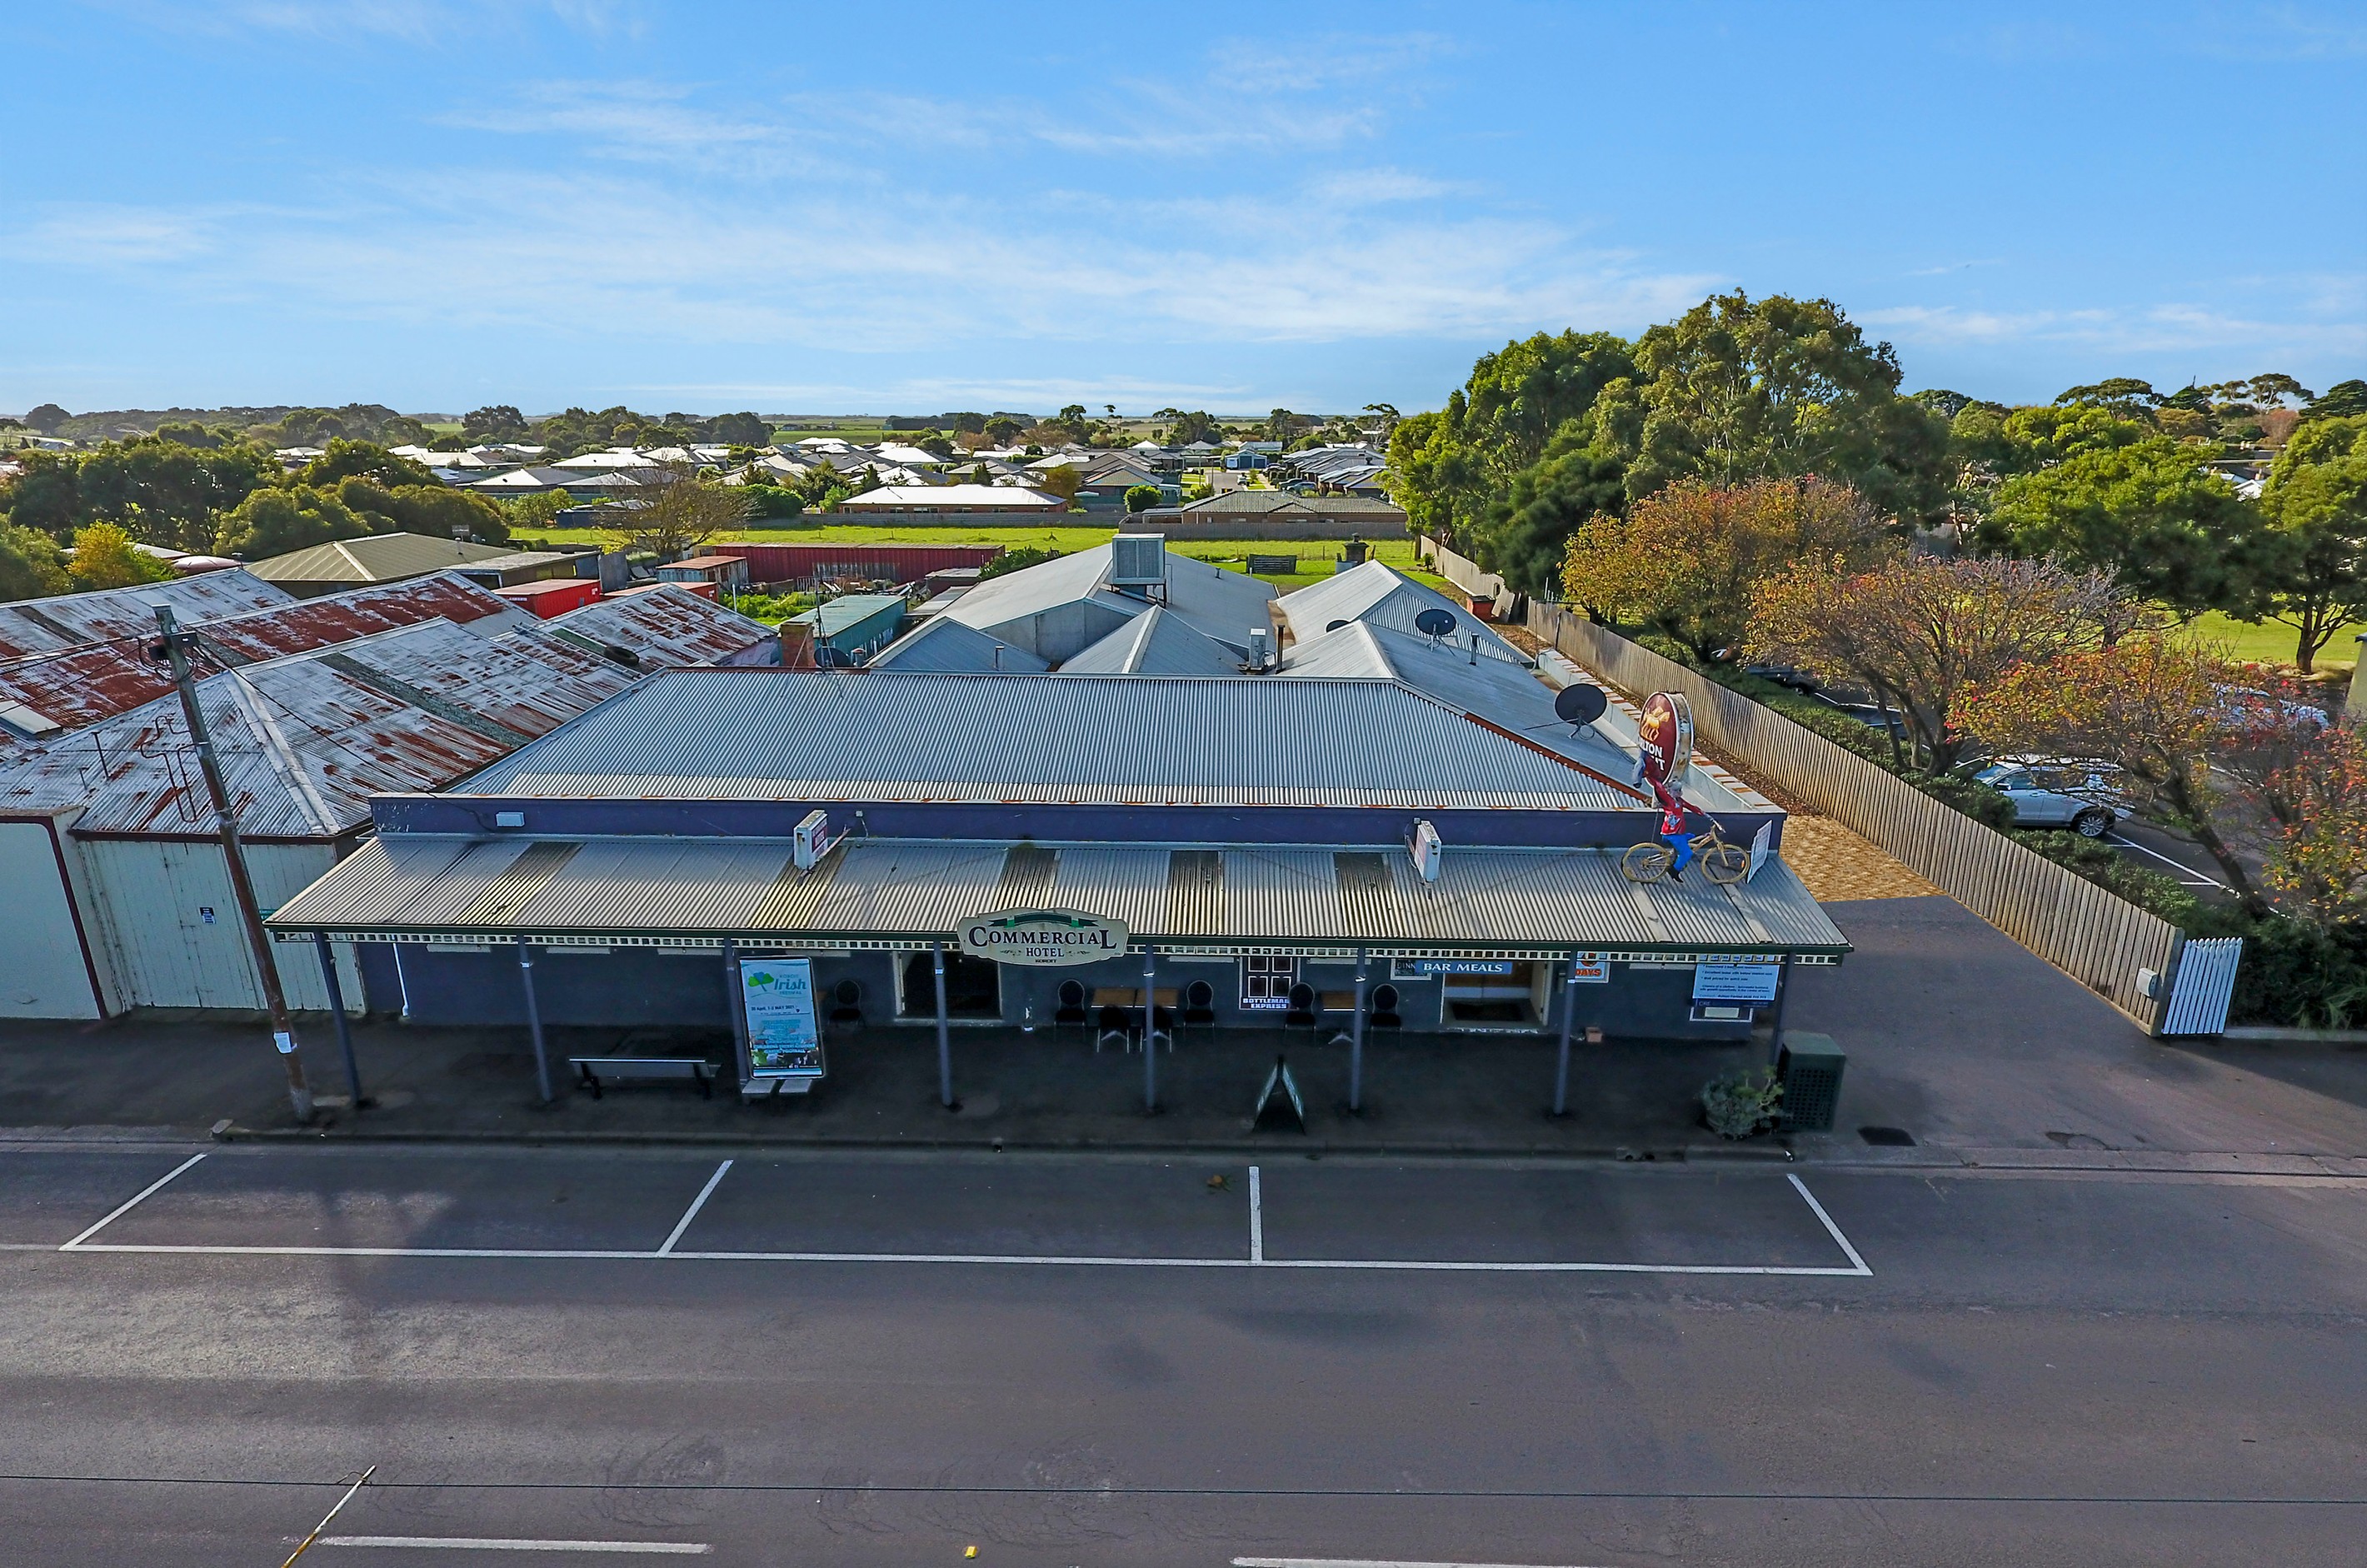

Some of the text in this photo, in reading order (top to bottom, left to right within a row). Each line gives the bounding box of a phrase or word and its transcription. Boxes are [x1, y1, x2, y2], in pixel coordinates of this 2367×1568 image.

[1640, 738, 1663, 758] LTON
[968, 926, 1117, 950] COMMERCIAL
[1026, 947, 1065, 957] HOTEL
[1396, 961, 1416, 970] DINN
[1423, 963, 1503, 972] BAR MEALS
[774, 979, 806, 990] Irish
